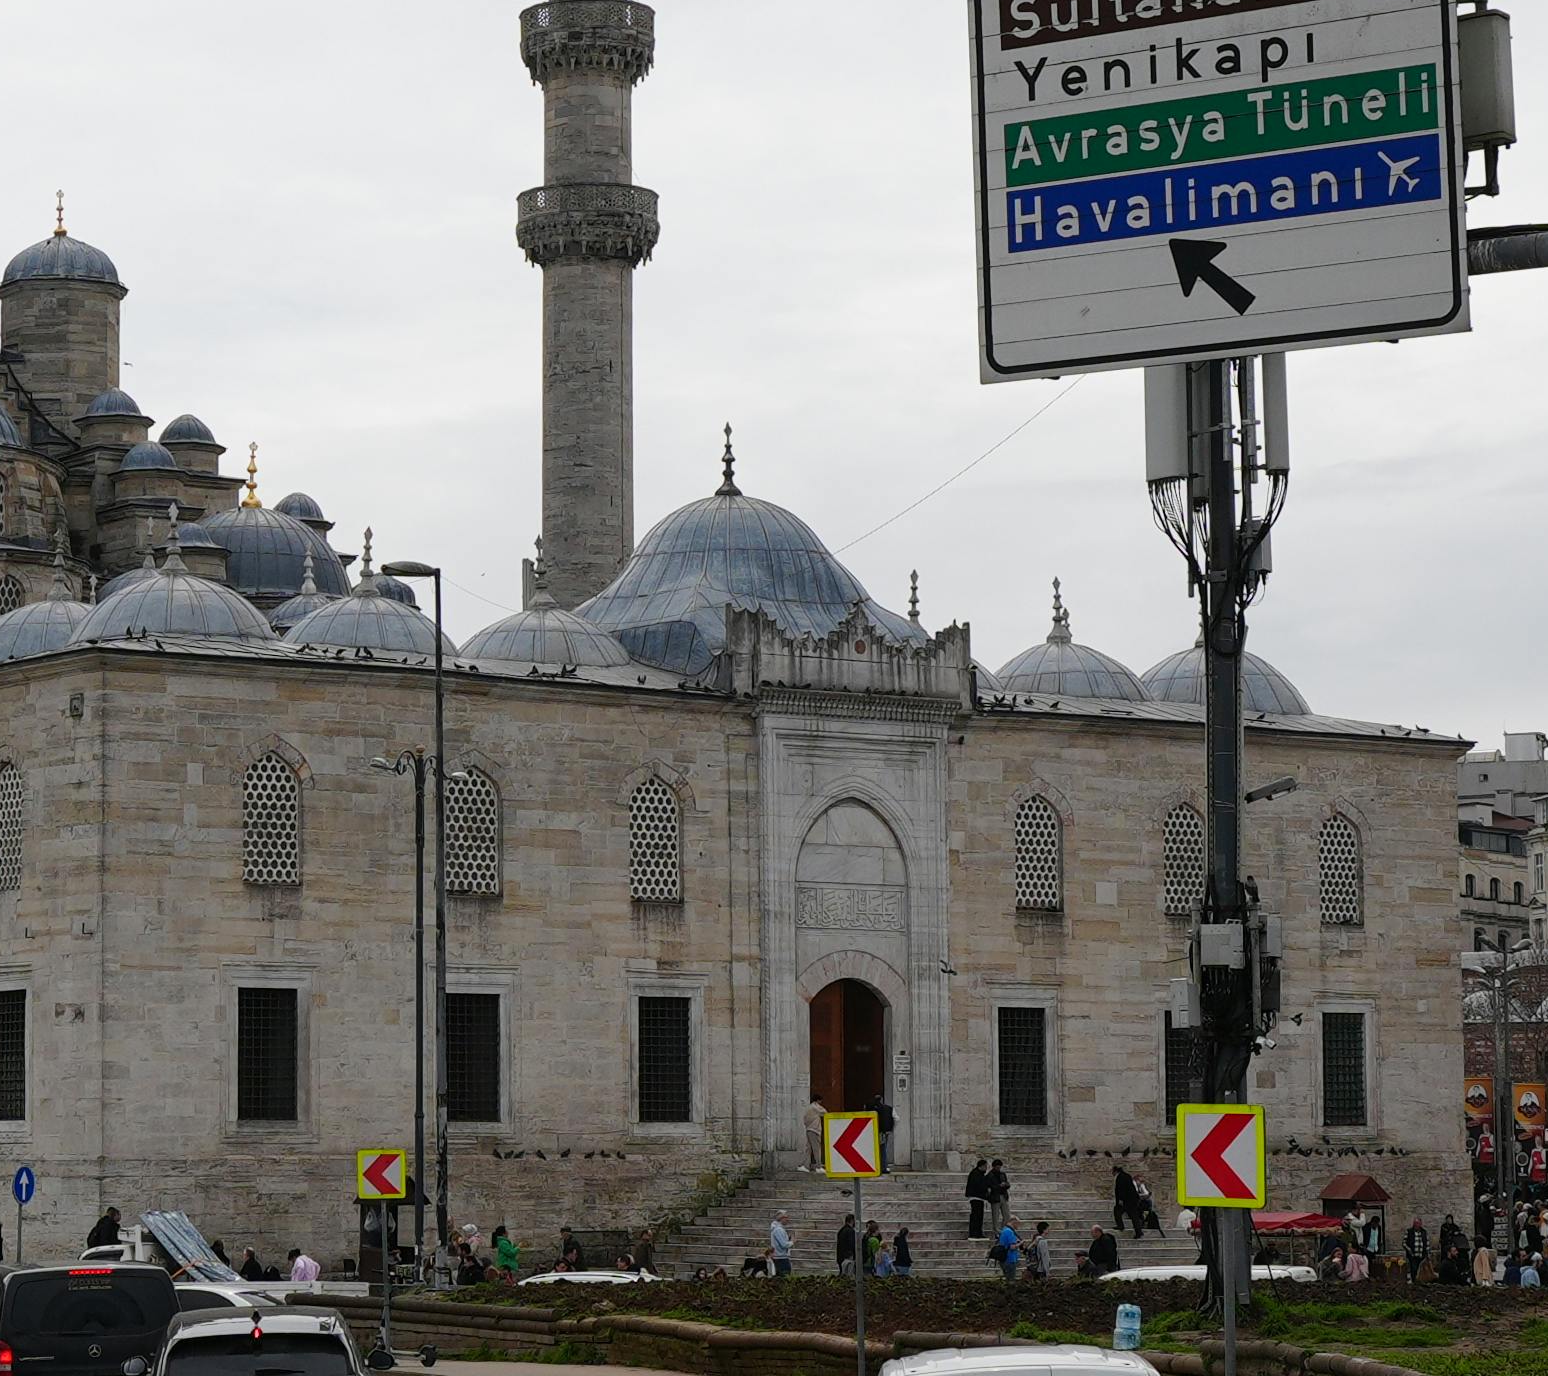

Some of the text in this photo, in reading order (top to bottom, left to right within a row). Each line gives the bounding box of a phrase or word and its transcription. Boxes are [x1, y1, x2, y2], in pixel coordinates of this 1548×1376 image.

[1014, 32, 1314, 102] Yenikapı
[1011, 72, 1430, 169] Avrasya Tüneli
[1013, 166, 1362, 244] Havalimanı
